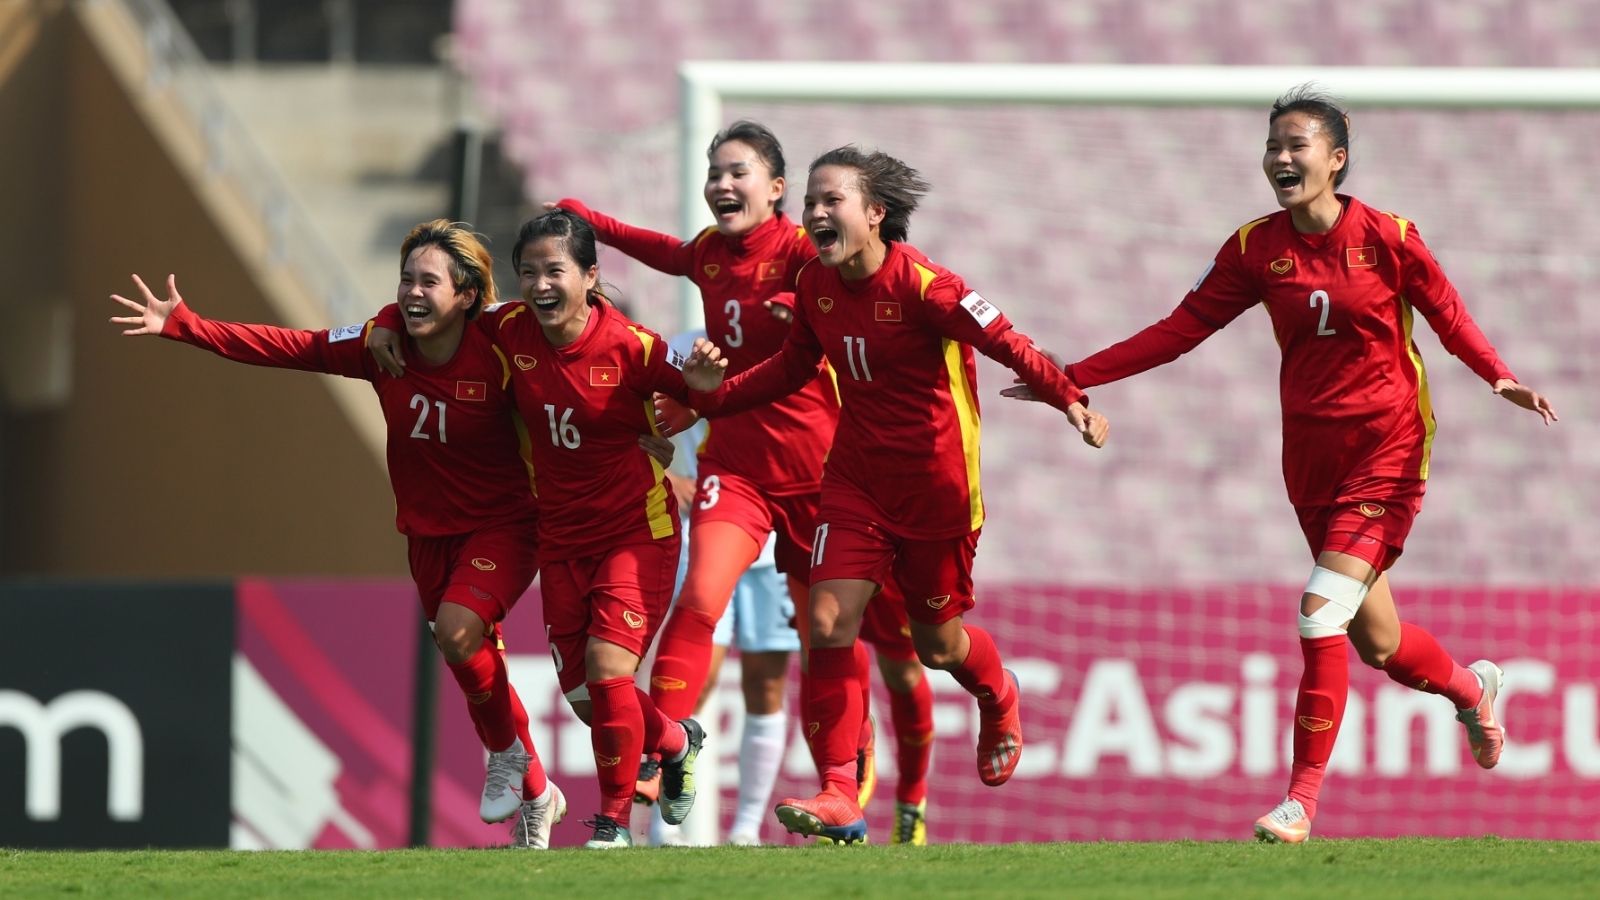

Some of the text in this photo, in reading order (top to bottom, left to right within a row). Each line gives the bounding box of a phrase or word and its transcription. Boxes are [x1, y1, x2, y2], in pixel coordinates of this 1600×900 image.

[724, 299, 744, 348] 3
[1309, 290, 1337, 336] 2
[843, 336, 873, 382] 11
[409, 393, 447, 443] 21
[544, 403, 581, 449] 16
[700, 475, 720, 510] 3
